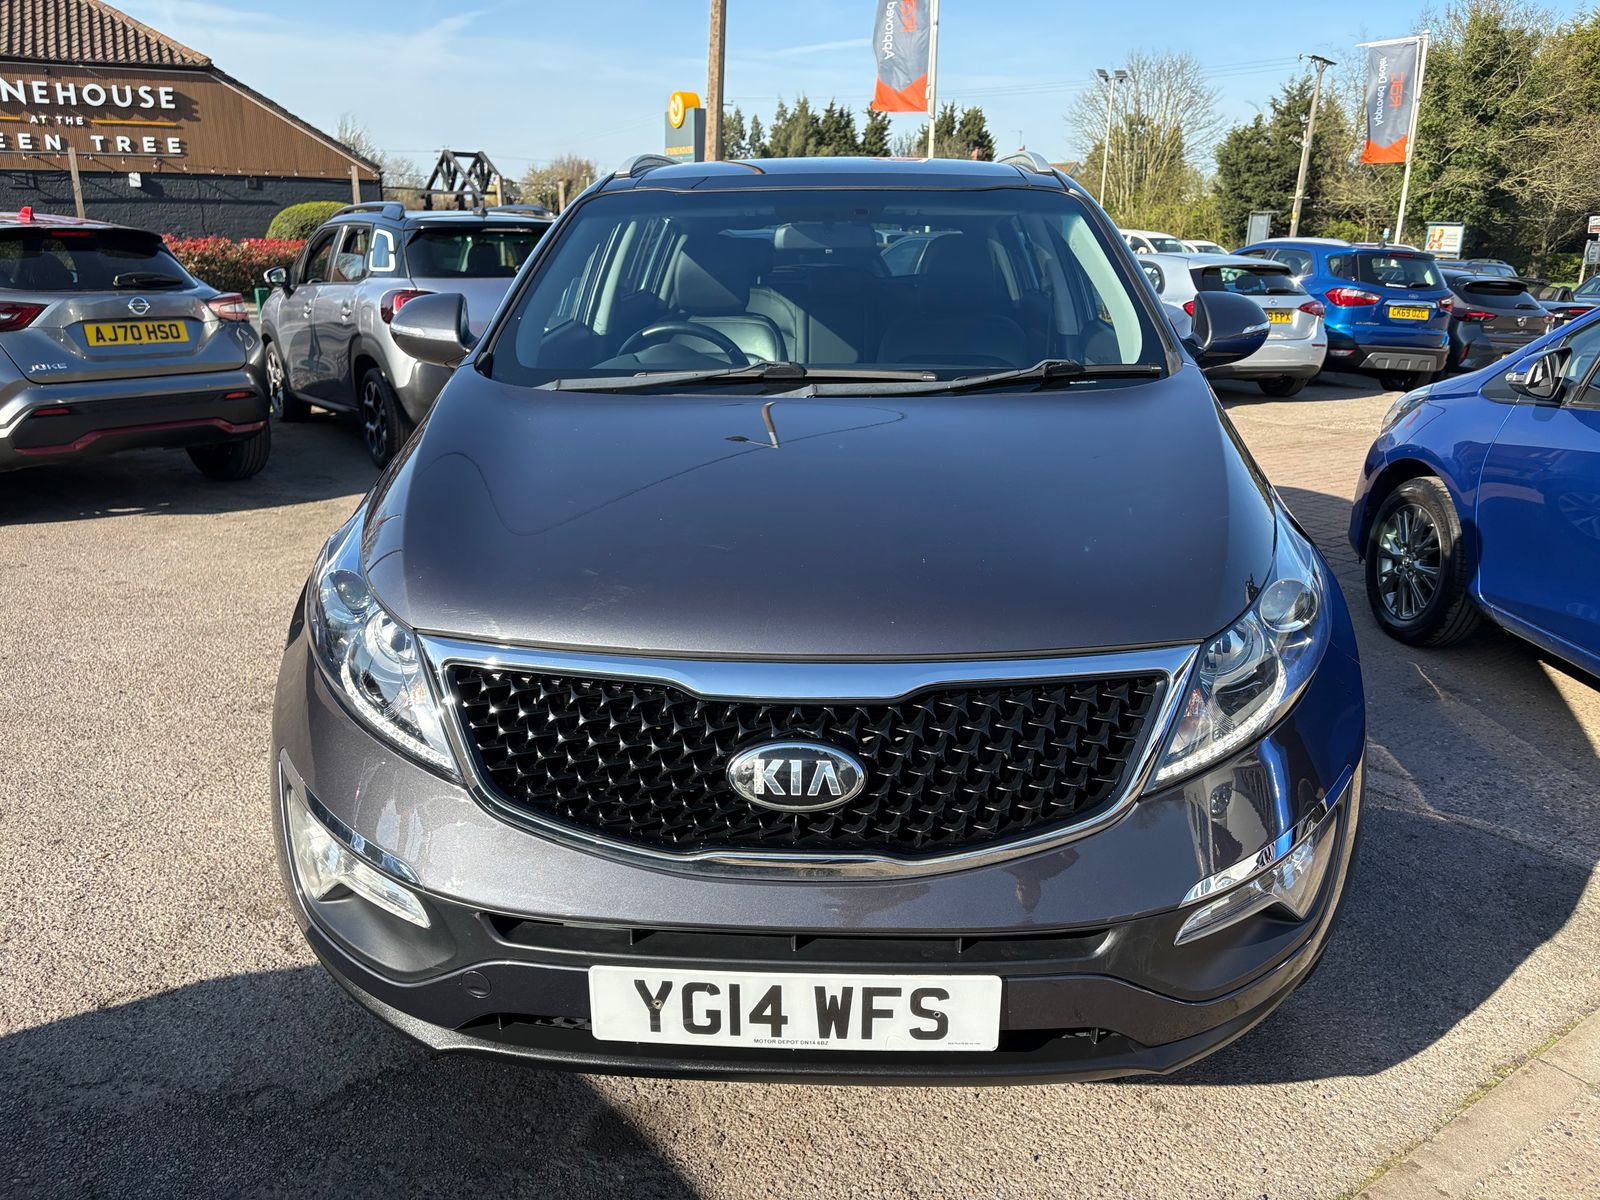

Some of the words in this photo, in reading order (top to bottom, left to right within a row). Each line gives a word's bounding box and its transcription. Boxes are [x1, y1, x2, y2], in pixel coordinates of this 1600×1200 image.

[29, 115, 47, 124] AT
[56, 116, 84, 126] THE
[90, 135, 182, 153] TREE
[95, 325, 143, 343] AJ70
[146, 323, 181, 340] HSO
[753, 758, 842, 797] KIA
[633, 978, 789, 1038] YG14
[814, 985, 951, 1041] WFS
